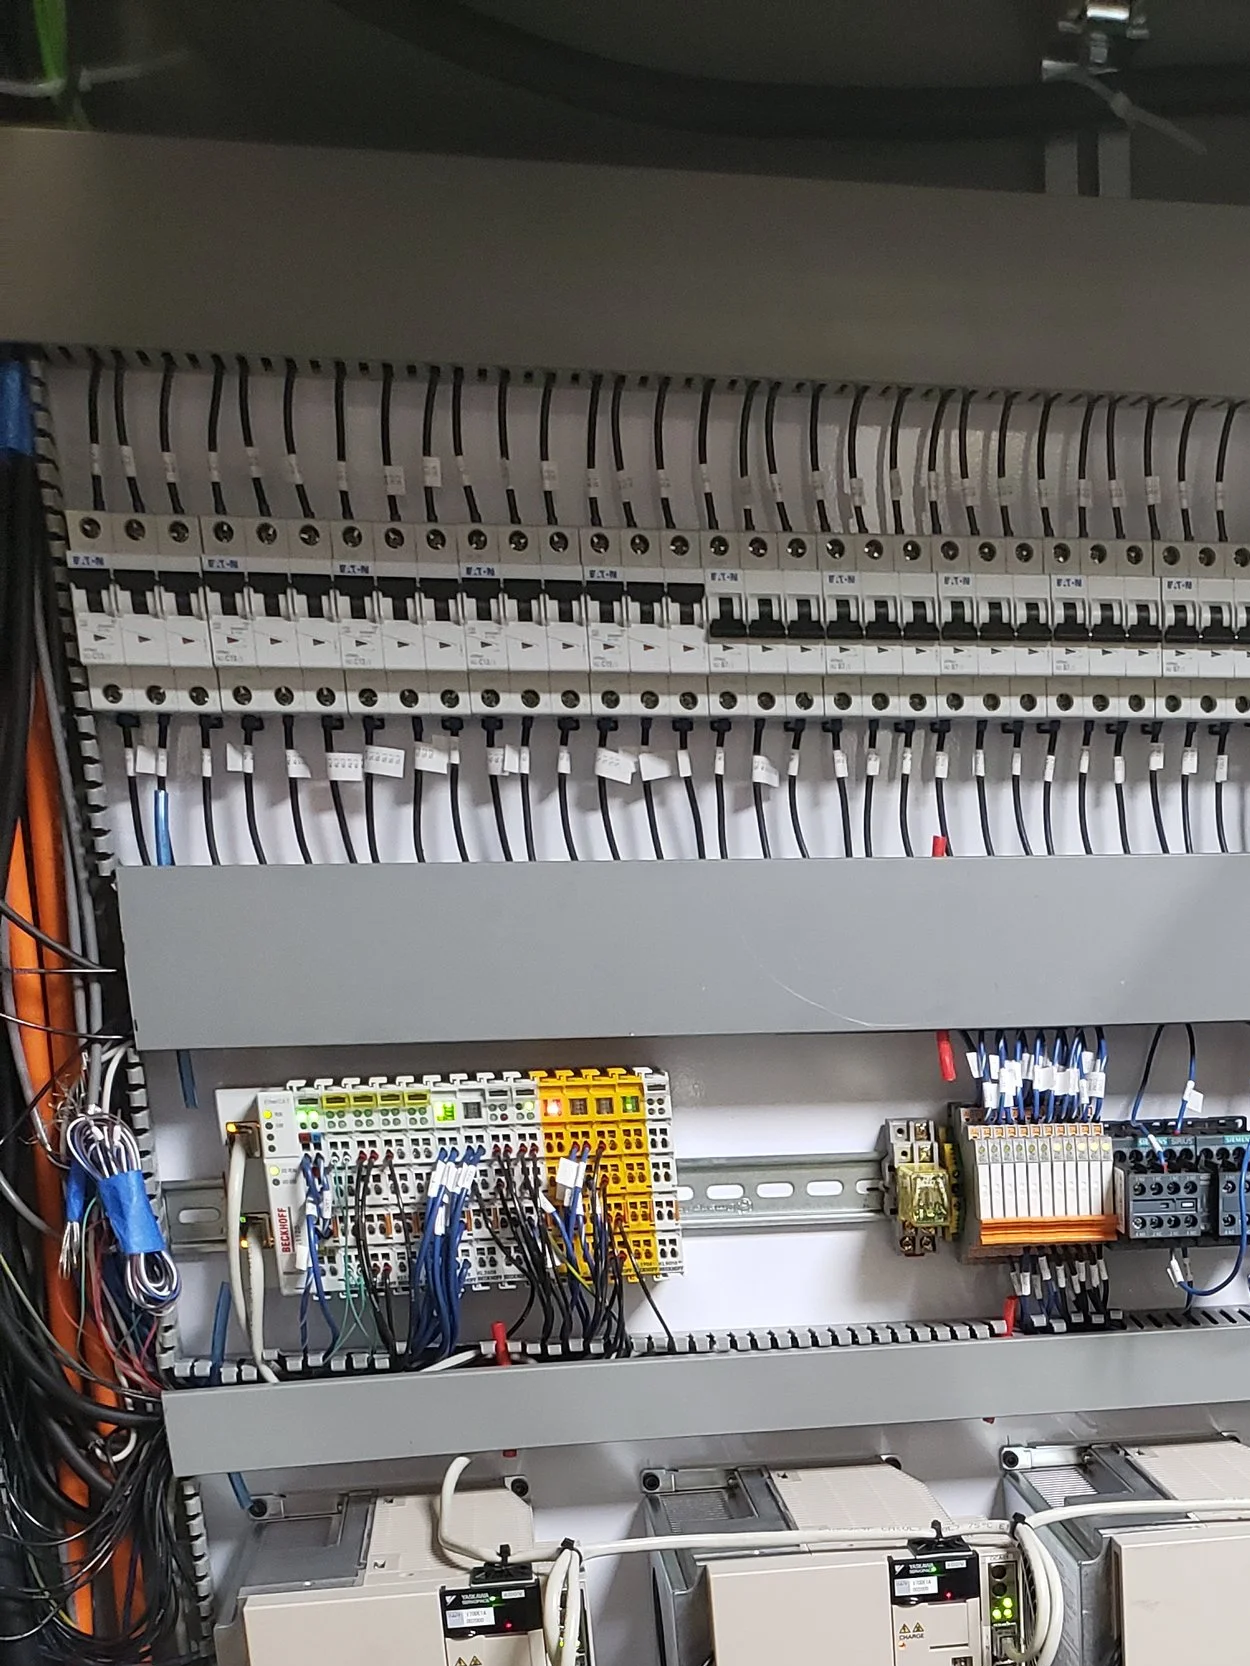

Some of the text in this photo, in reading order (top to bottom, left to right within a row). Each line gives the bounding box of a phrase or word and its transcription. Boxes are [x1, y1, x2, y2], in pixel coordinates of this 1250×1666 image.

[277, 1207, 291, 1253] BECKHOFF
[461, 1592, 490, 1600] YASKAWA
[898, 1632, 925, 1641] CHARGE
